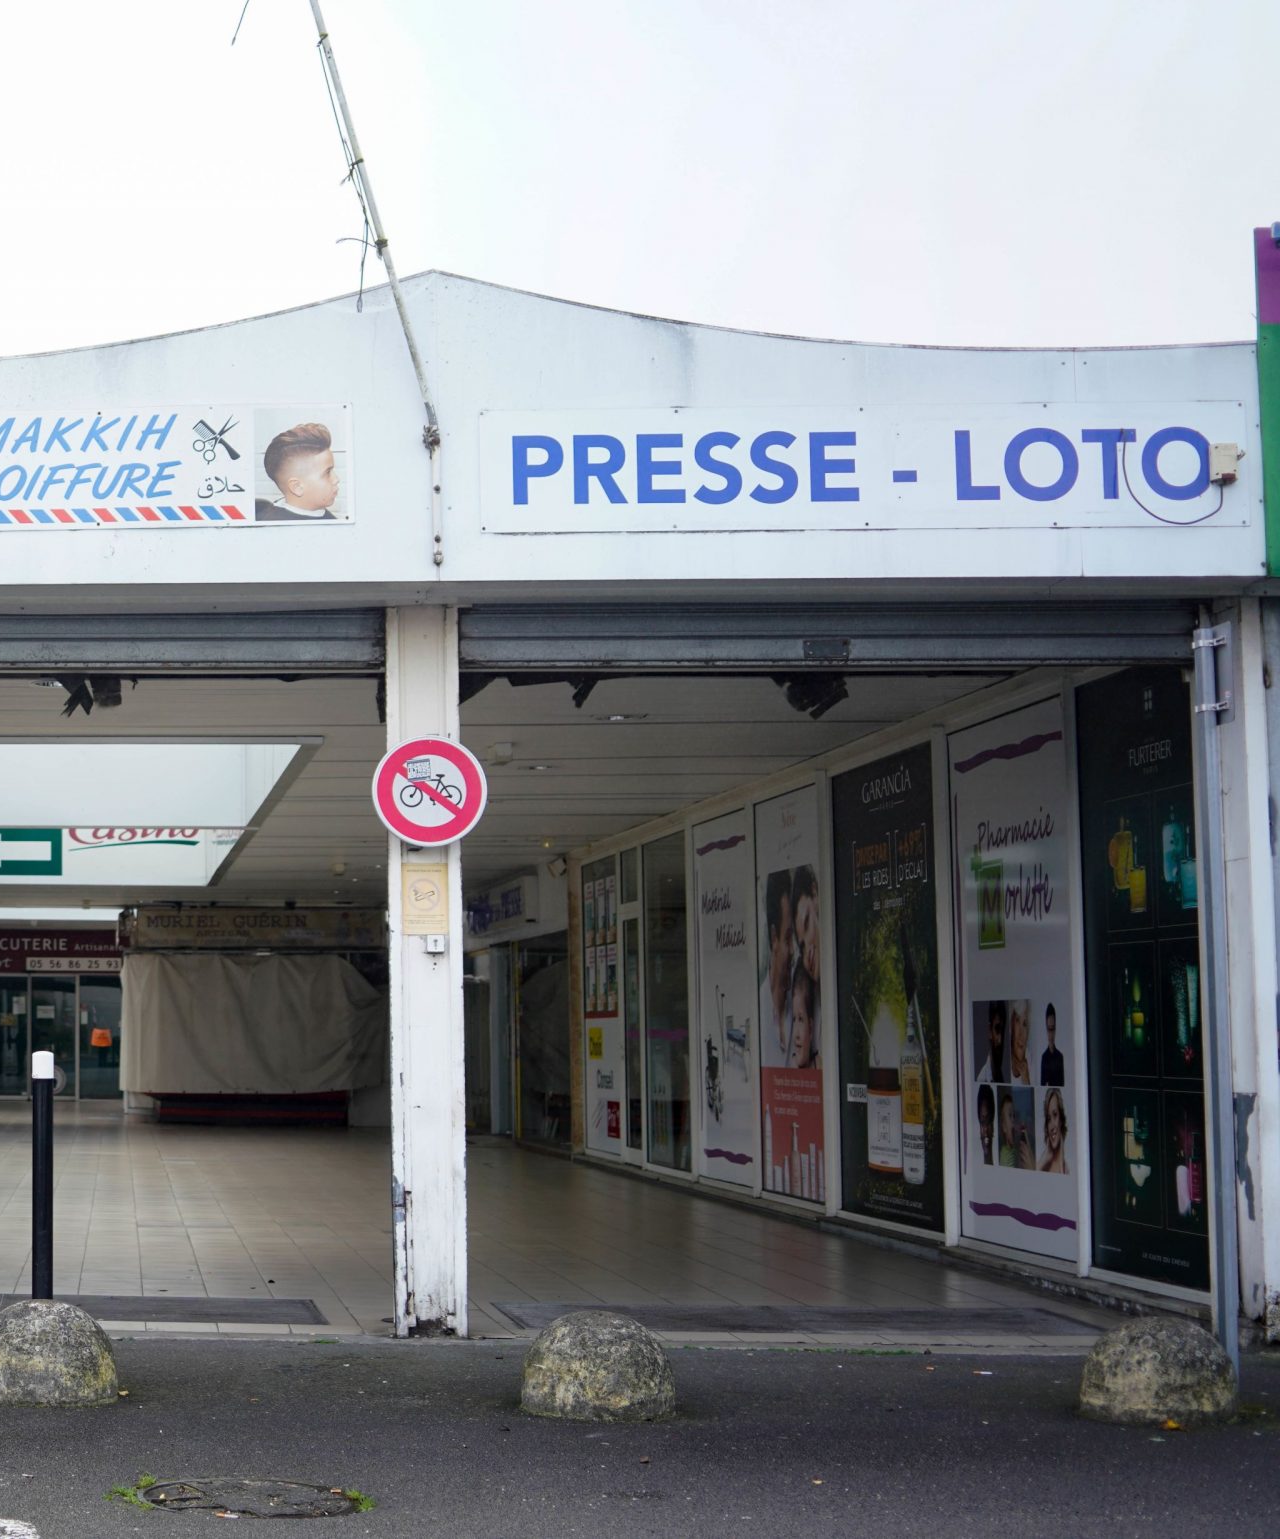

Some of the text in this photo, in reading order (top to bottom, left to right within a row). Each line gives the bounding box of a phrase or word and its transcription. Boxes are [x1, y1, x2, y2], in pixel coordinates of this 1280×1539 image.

[512, 426, 1211, 505] PRESSE - LOTO
[197, 475, 245, 499] حلاق
[1129, 739, 1173, 768] FURTERER
[978, 806, 1054, 853] Pharmacie
[982, 863, 1054, 934] Morlette
[147, 912, 307, 928] MURIEL GUÉRIN
[716, 921, 746, 950] Médical
[30, 960, 119, 969] 05 56 86 25 93
